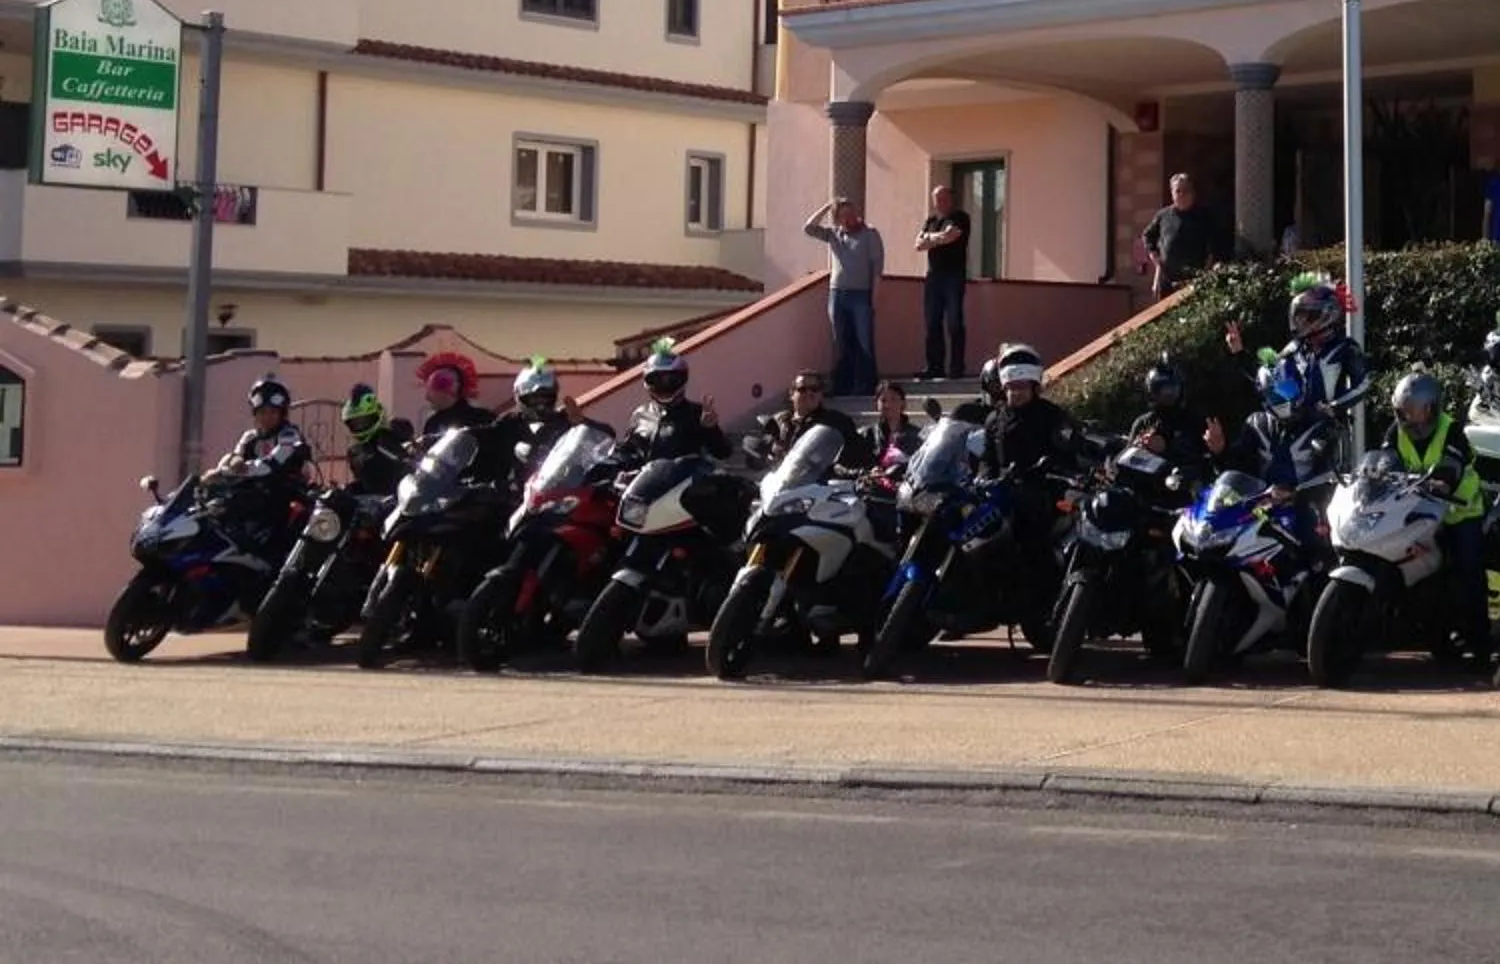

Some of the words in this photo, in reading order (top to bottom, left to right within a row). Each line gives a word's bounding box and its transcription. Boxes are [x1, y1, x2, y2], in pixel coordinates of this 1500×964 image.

[55, 28, 97, 53] Baia
[106, 34, 176, 61] Marina
[97, 59, 136, 77] Bar
[62, 77, 166, 101] Caffetteria
[93, 147, 133, 174] sky
